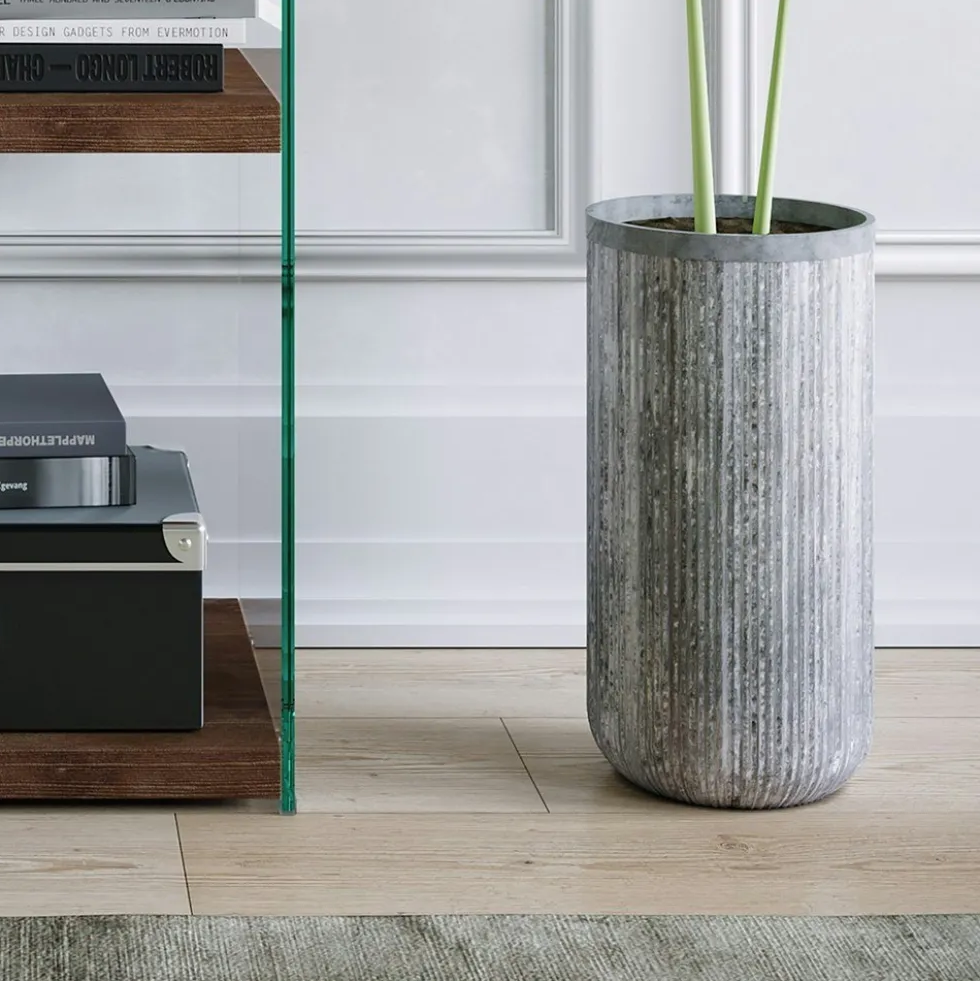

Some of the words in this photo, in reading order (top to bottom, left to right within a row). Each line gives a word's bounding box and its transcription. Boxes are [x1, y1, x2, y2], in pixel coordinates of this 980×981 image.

[12, 26, 56, 37] DESIGN
[63, 26, 113, 38] GADGETS
[121, 26, 150, 38] FROM
[157, 26, 229, 38] EVERMOTION
[75, 53, 139, 82] LONGO
[143, 53, 218, 82] ROBERT
[0, 434, 95, 447] MAPPLETHORPE
